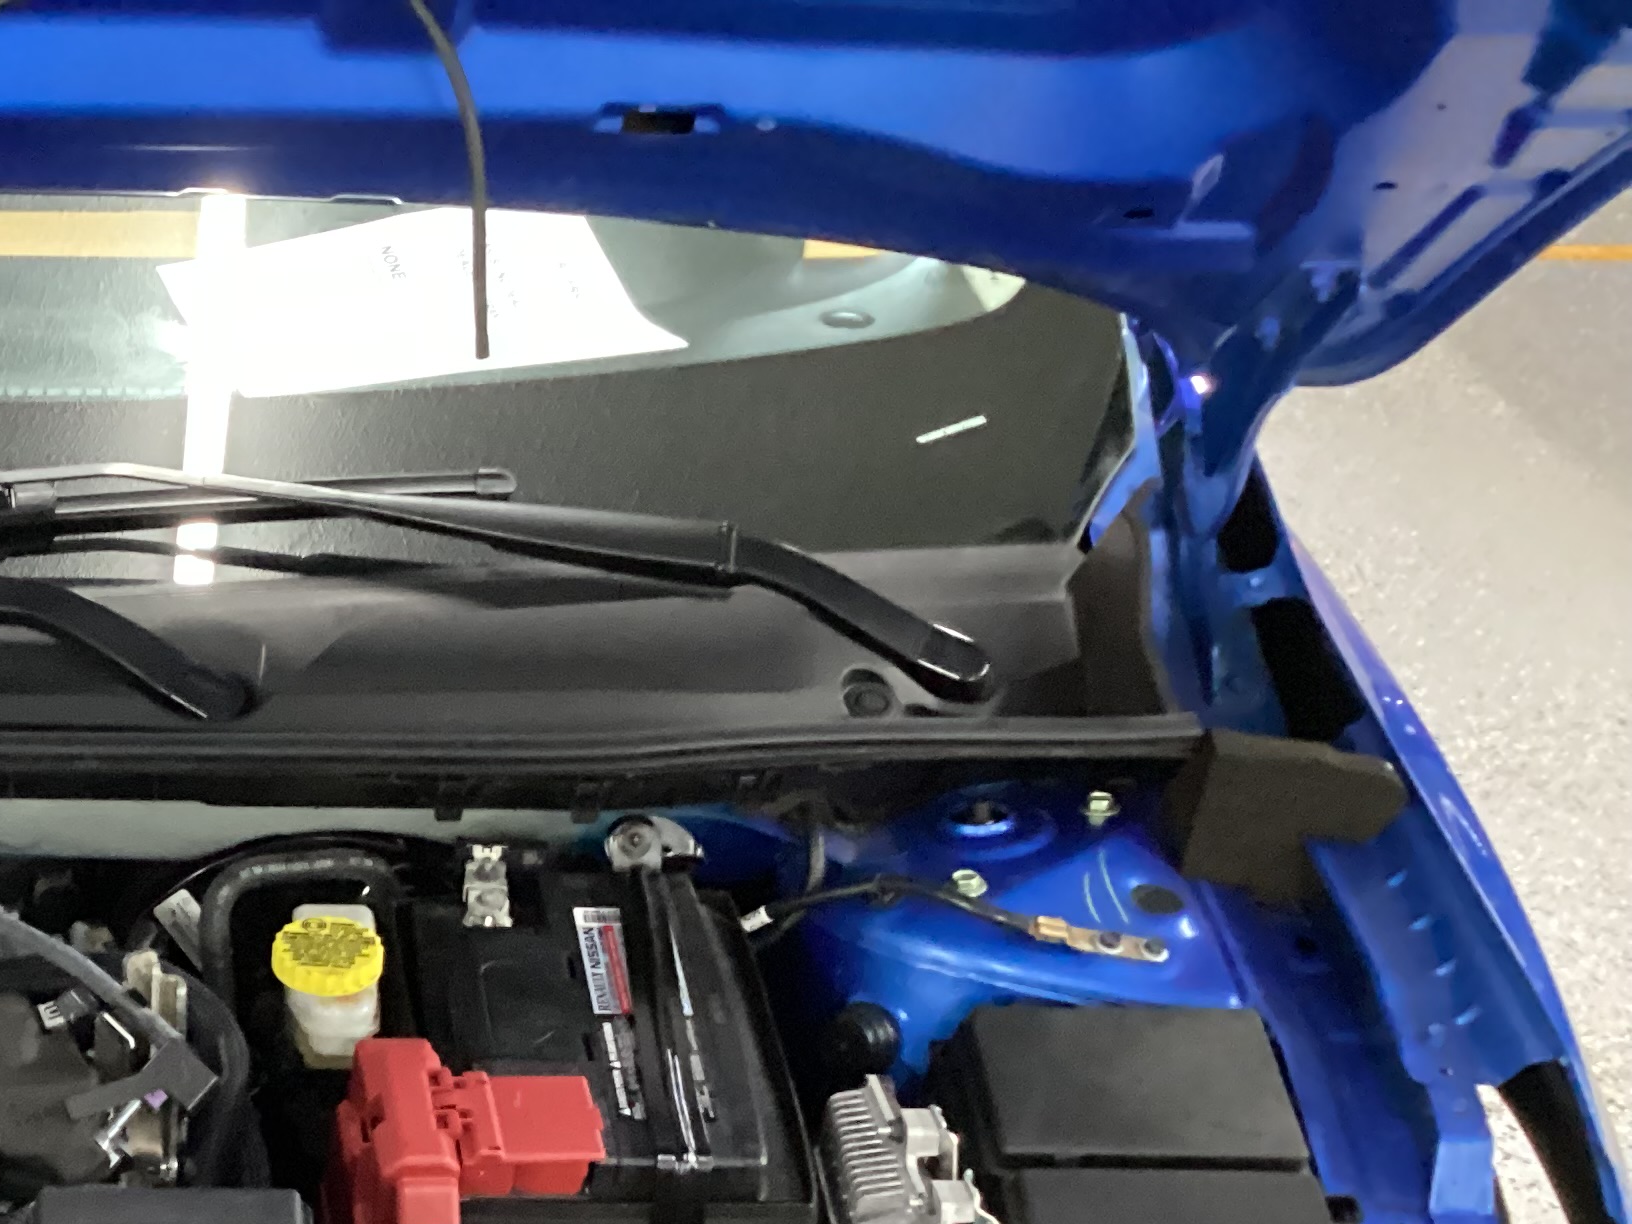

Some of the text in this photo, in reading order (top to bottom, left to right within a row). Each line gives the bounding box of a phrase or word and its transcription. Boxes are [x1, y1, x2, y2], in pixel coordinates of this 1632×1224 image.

[381, 245, 407, 280] NONE
[581, 926, 612, 1011] RENAULT NISSAN
